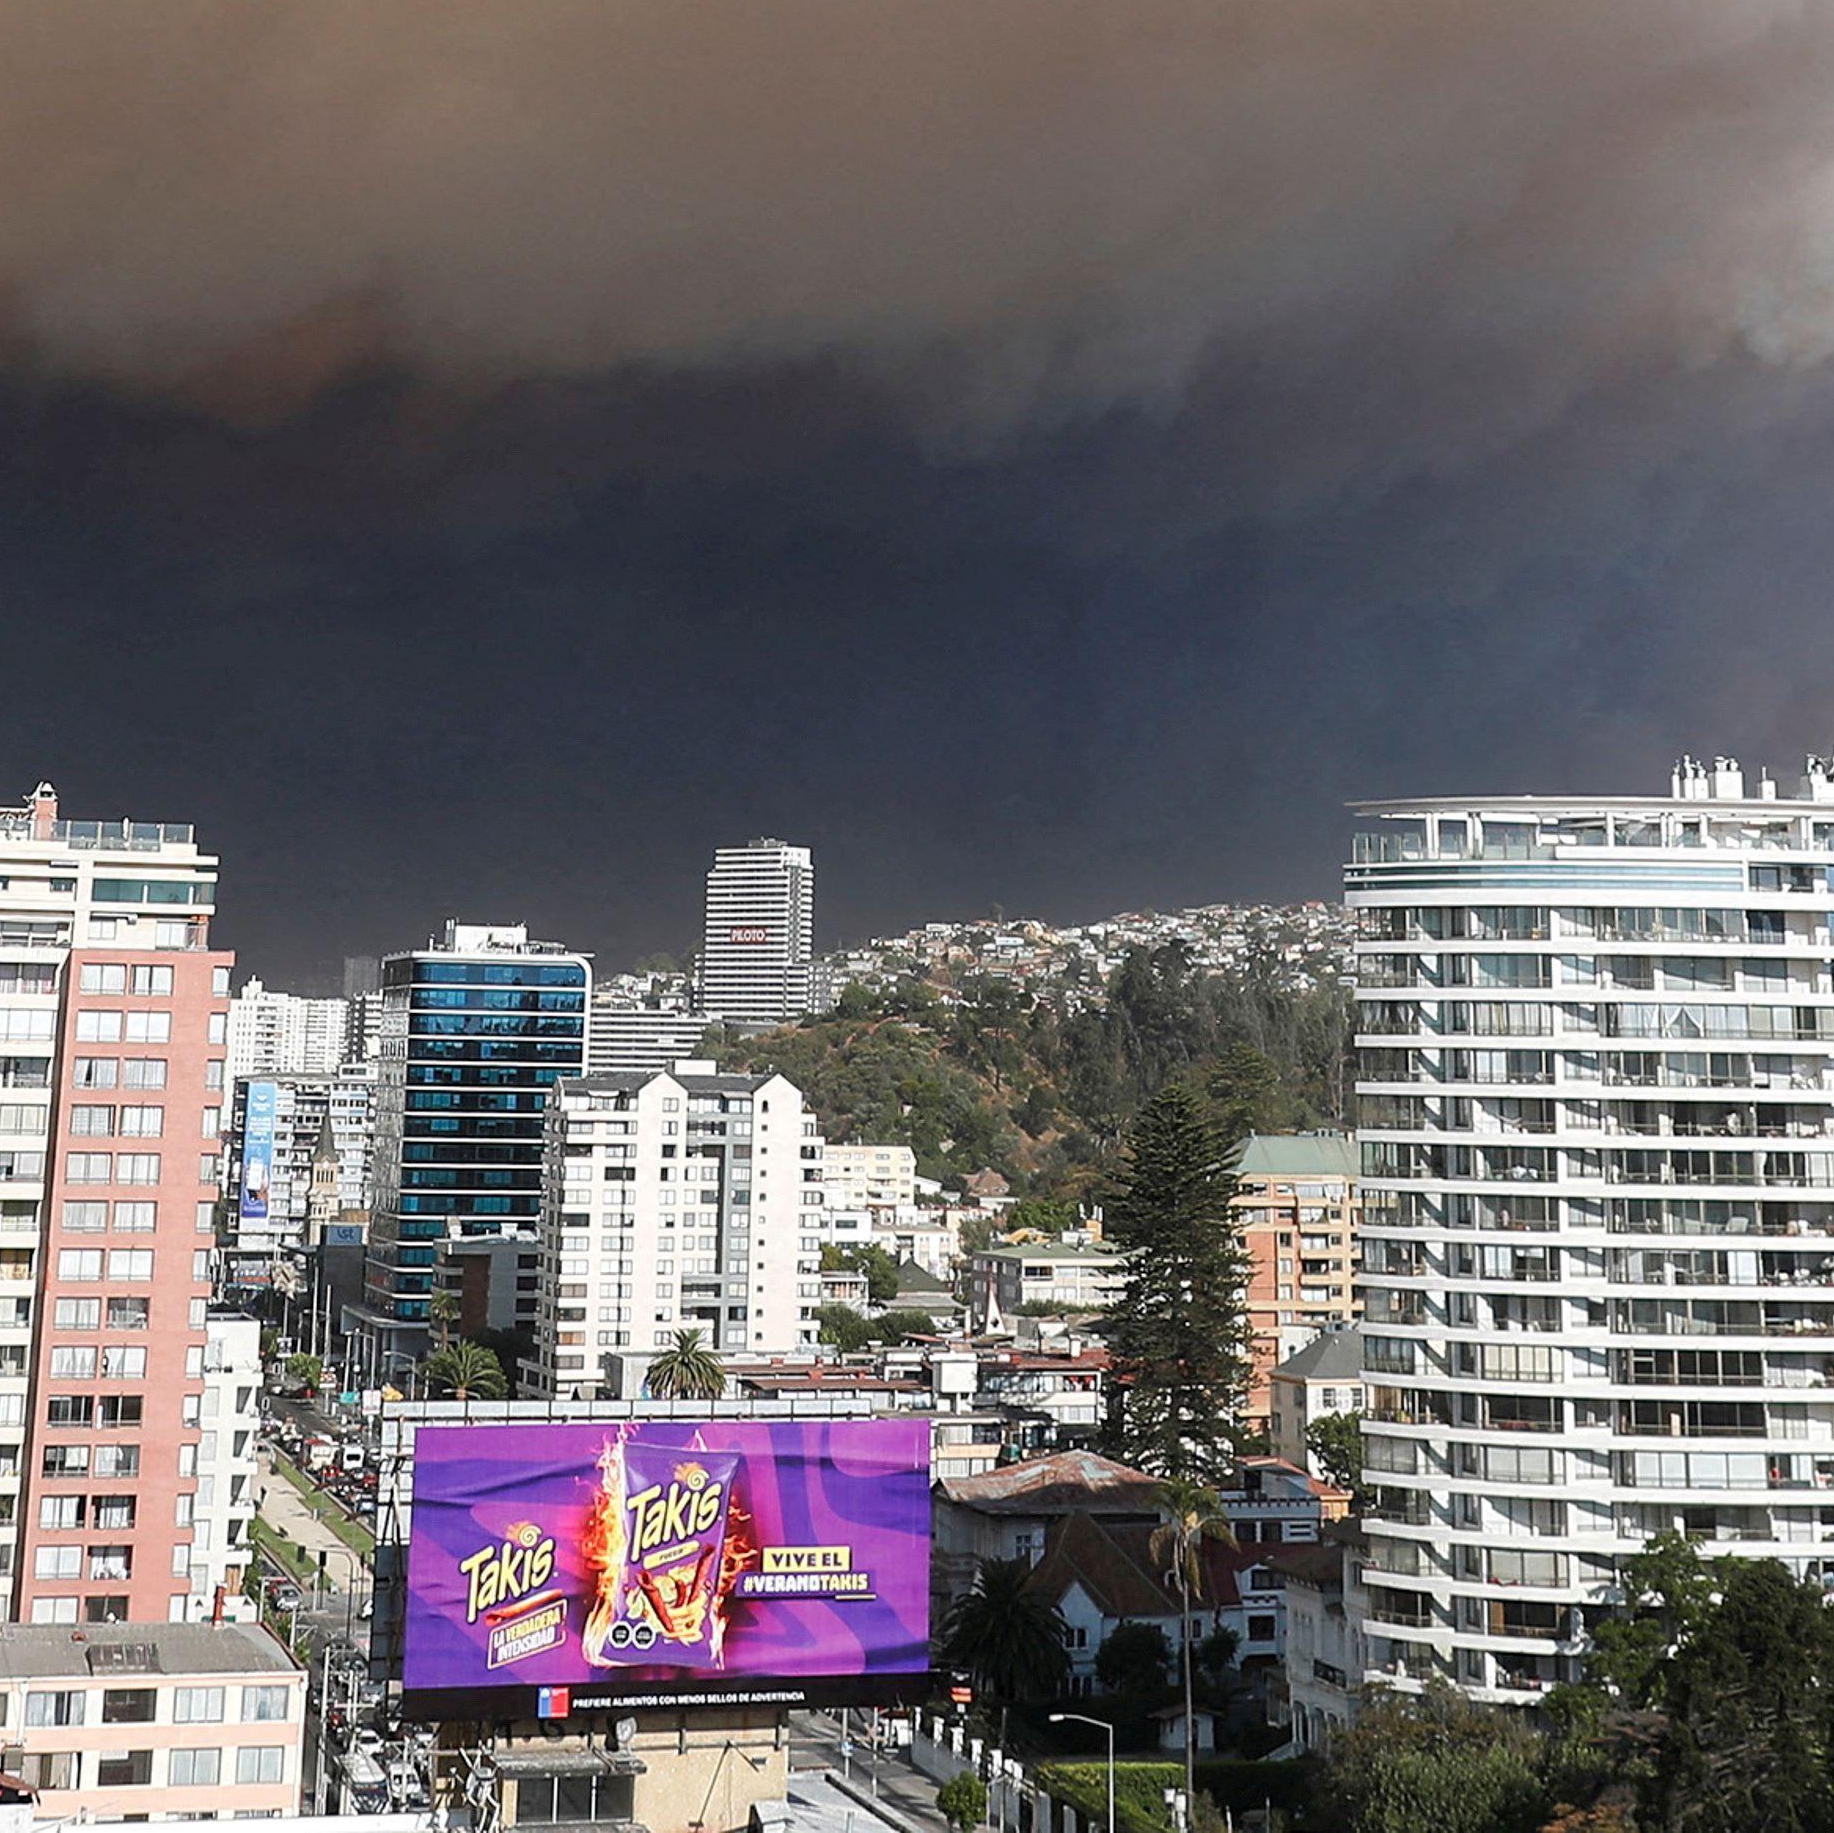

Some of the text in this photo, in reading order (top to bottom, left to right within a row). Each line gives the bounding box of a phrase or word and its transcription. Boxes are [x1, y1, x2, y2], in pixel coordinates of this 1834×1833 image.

[626, 1472, 722, 1563] Takis
[460, 1527, 554, 1624] Takis
[771, 1553, 842, 1567] VIVE EL
[497, 1626, 555, 1662] INTENSIDAD
[572, 1690, 805, 1708] PREFIERE ALIMENTOS CON MENOS SELLOS DE ADVERTENCIA
